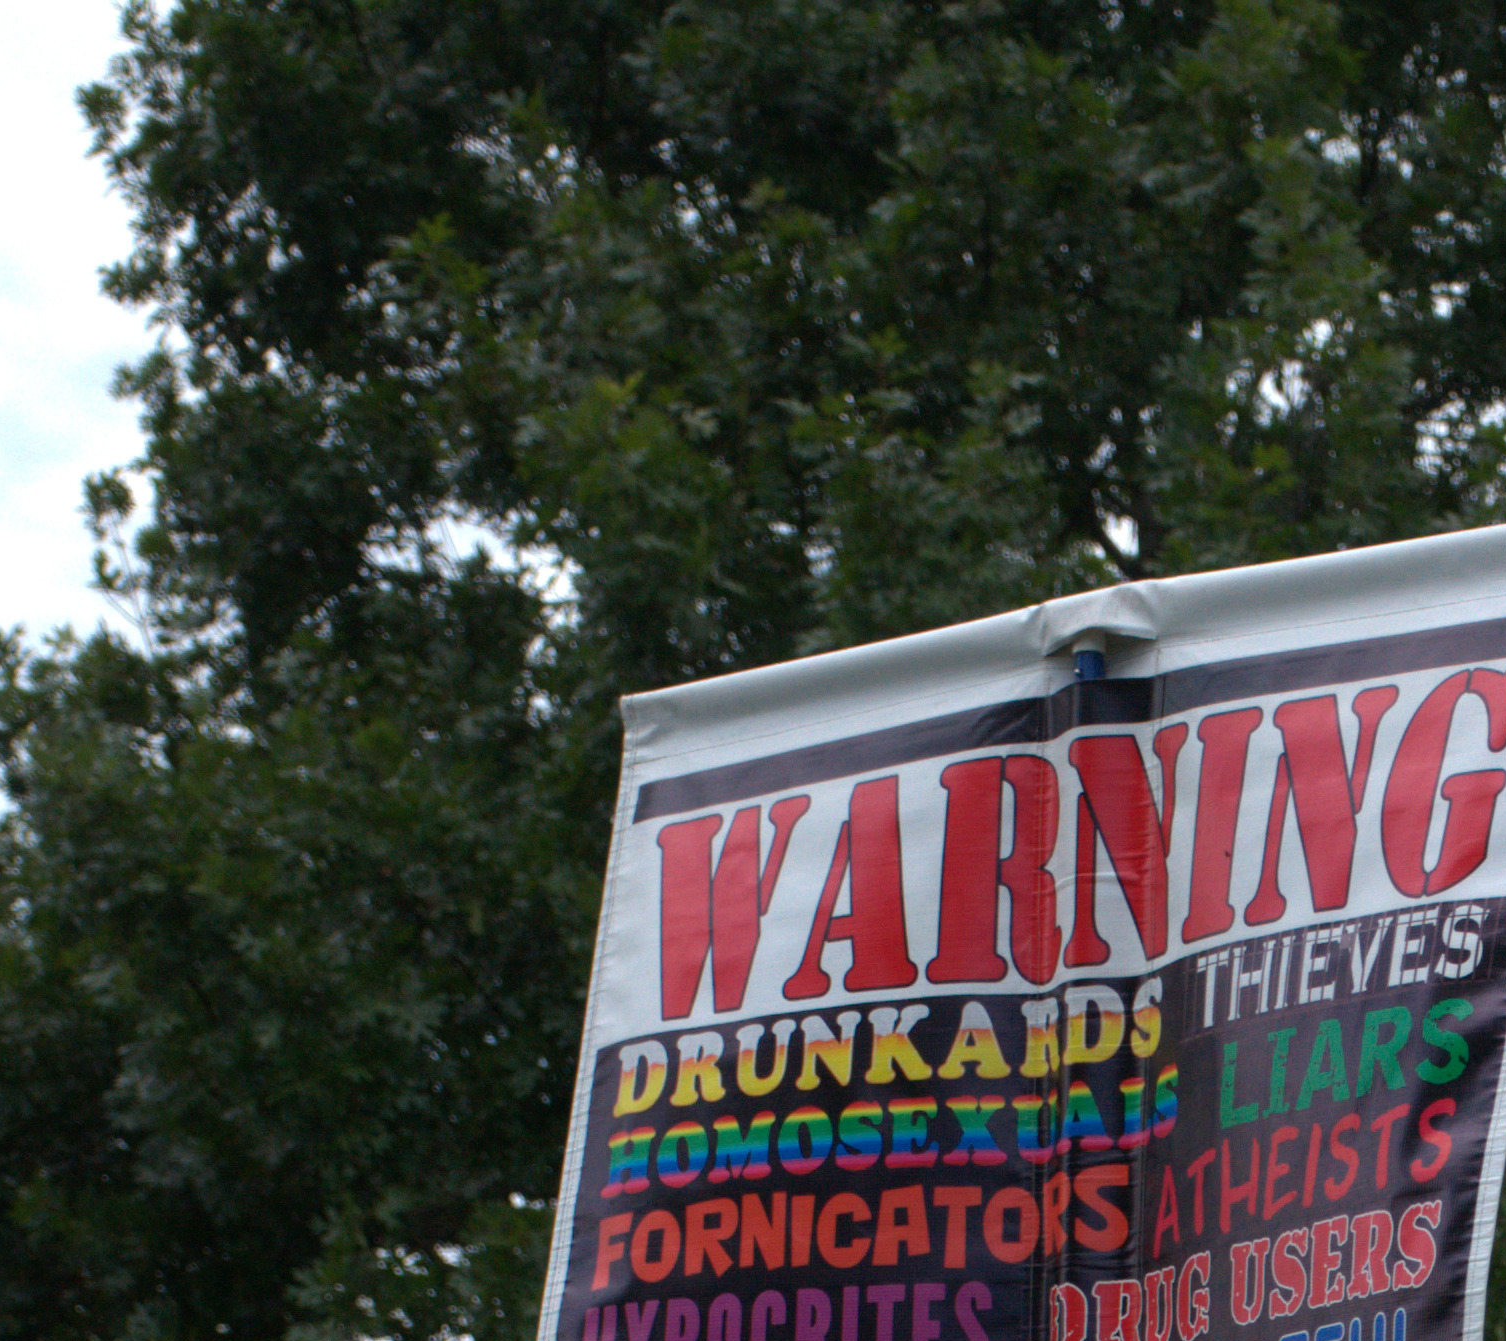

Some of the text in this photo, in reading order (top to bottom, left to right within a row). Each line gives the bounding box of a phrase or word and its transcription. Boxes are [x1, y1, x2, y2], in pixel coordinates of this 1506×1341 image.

[1196, 903, 1489, 1028] THIEVES
[613, 976, 1165, 1117] DRUNKARDS
[1220, 998, 1474, 1129] LIARS
[600, 1064, 1178, 1198] HOMOSEXUALS
[1153, 1097, 1457, 1256] ATHEISTS
[592, 1164, 1131, 1291] FORNICATORS
[1230, 1202, 1441, 1325] USERS
